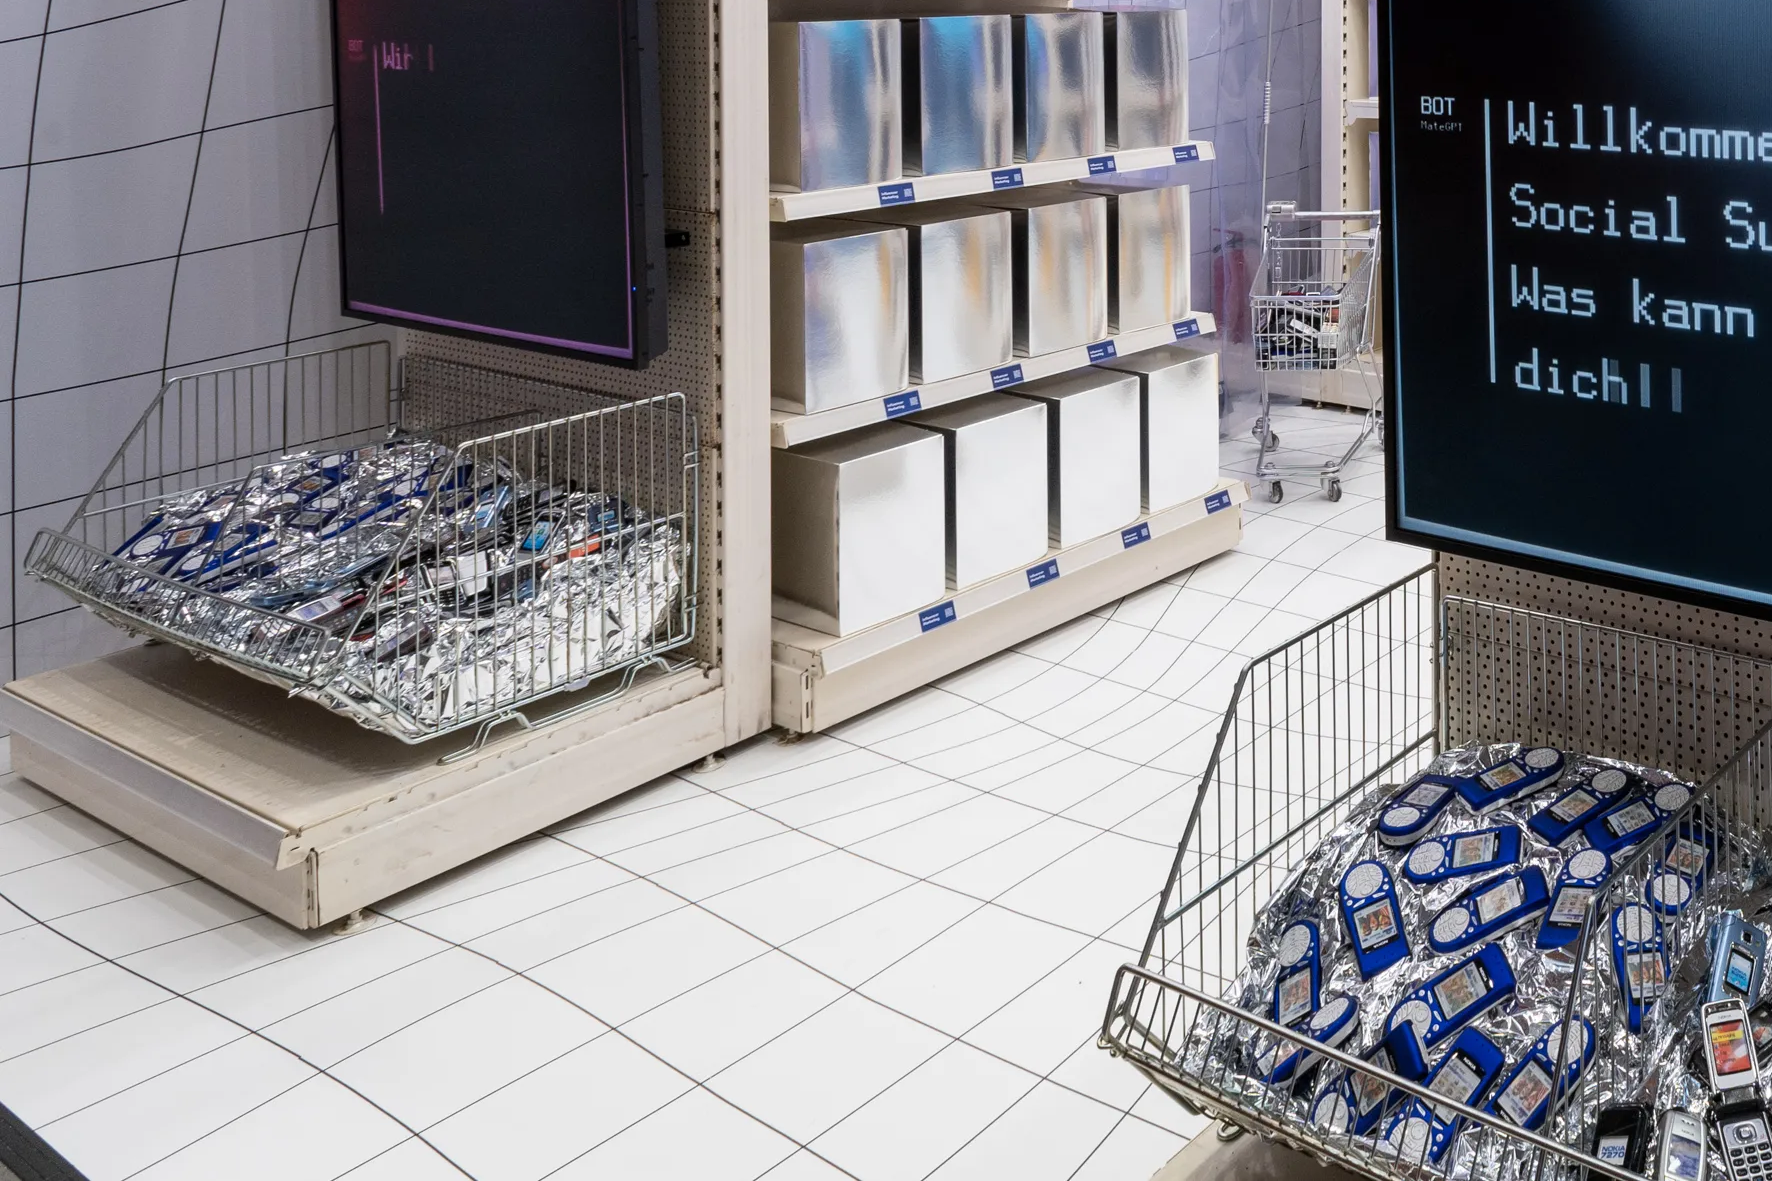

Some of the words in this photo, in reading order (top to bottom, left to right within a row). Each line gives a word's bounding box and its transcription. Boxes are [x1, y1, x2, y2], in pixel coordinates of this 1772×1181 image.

[1420, 96, 1456, 116] BOT
[1420, 120, 1463, 133] MateGPT
[1509, 182, 1686, 244] Social
[1511, 264, 1596, 318] Was
[1632, 278, 1755, 338] kann
[1600, 1151, 1625, 1159] 7270
[1602, 1145, 1625, 1153] NOKIA
